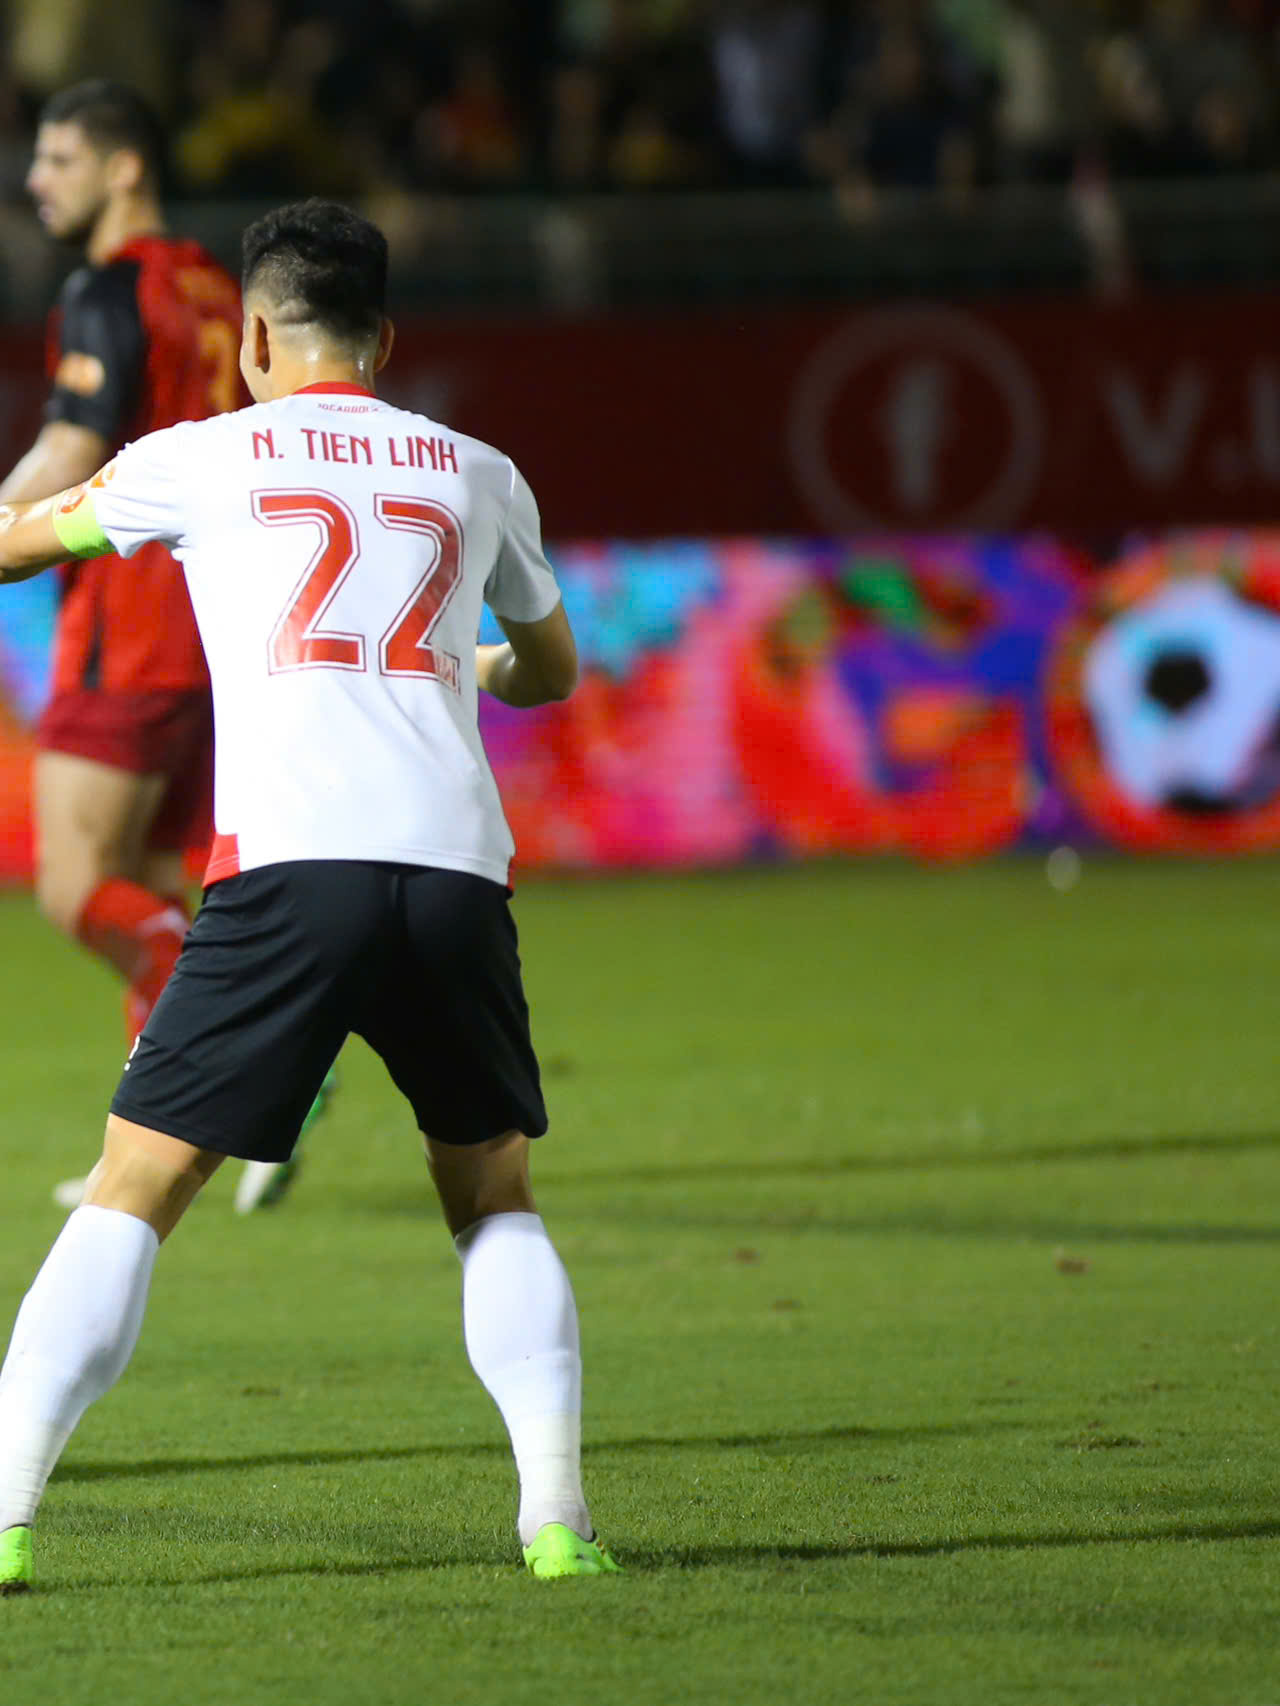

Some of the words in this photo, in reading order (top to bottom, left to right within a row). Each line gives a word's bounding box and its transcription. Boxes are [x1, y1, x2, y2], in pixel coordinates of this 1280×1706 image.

[251, 428, 284, 460] N.
[300, 428, 373, 465] TIEN
[388, 436, 459, 474] LINH
[250, 488, 463, 696] 22
